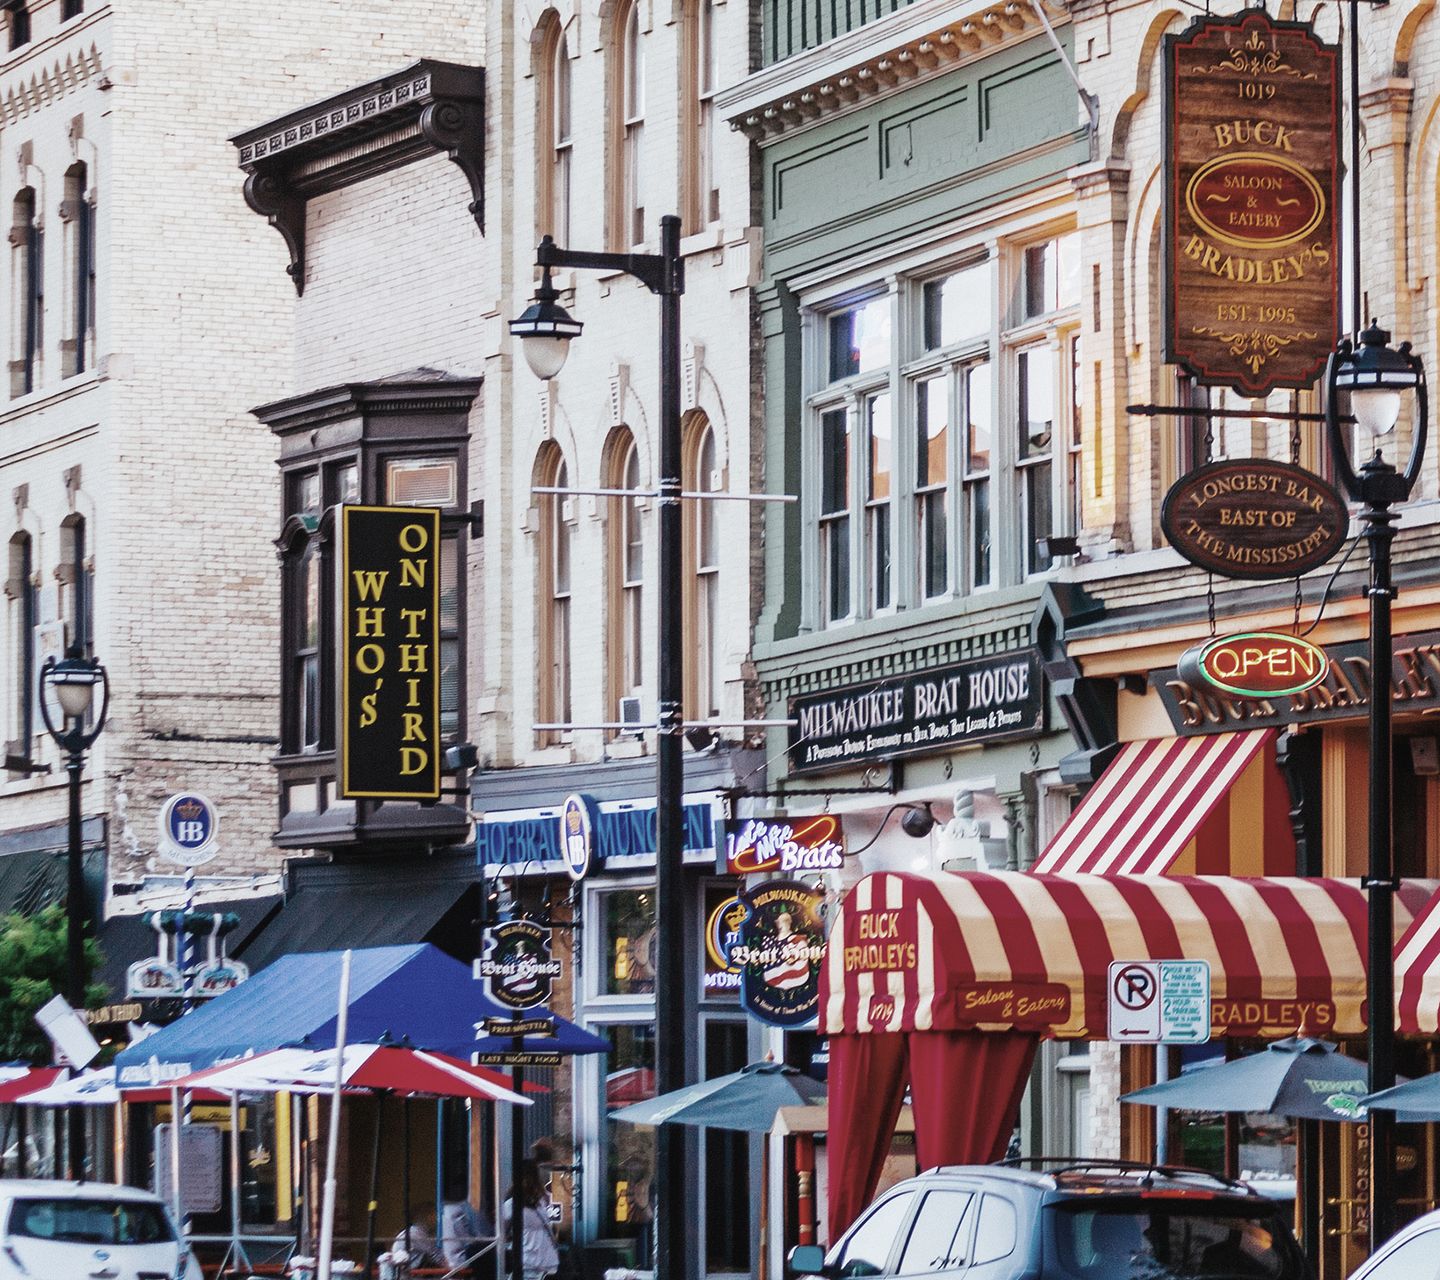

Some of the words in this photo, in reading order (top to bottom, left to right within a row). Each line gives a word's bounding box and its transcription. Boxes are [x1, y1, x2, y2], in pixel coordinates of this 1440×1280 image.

[1239, 82, 1276, 99] 1019
[1214, 120, 1296, 151] BUCK
[1224, 174, 1283, 191] SALOON
[1247, 195, 1259, 209] &
[1229, 211, 1283, 228] EATERY
[1184, 233, 1331, 285] BRADLEY'S
[1217, 304, 1252, 322] EST.
[1258, 305, 1296, 324] 1995
[1190, 473, 1281, 509] LONGEST
[1286, 481, 1325, 513] BAR
[1220, 509, 1269, 528] EAST
[1271, 511, 1297, 528] OF
[399, 524, 428, 588] ON
[1186, 520, 1225, 556] THE
[1226, 525, 1333, 565] MISSISSIPPI
[353, 570, 389, 728] WHO'S
[1211, 647, 1315, 679] OPEN
[398, 608, 428, 776] THIRD
[800, 686, 904, 739] MILWAUKEE
[914, 676, 961, 720] BRAT
[968, 661, 1030, 708] HOUSE
[178, 821, 204, 842] HB
[781, 840, 843, 871] Brats
[752, 888, 815, 908] MILWAUKEE
[859, 912, 899, 940] BUCK
[481, 961, 516, 976] Brat
[517, 958, 560, 978] House
[731, 945, 781, 968] Brat
[781, 940, 827, 967] Hou
[844, 942, 917, 972] BRADLEY'S
[1162, 966, 1169, 983] 2
[965, 989, 1015, 1009] Saloon
[1002, 1002, 1013, 1018] &
[1017, 996, 1066, 1017] Eatery
[1163, 998, 1171, 1016] 2
[1211, 1002, 1331, 1026] RADLEY'S
